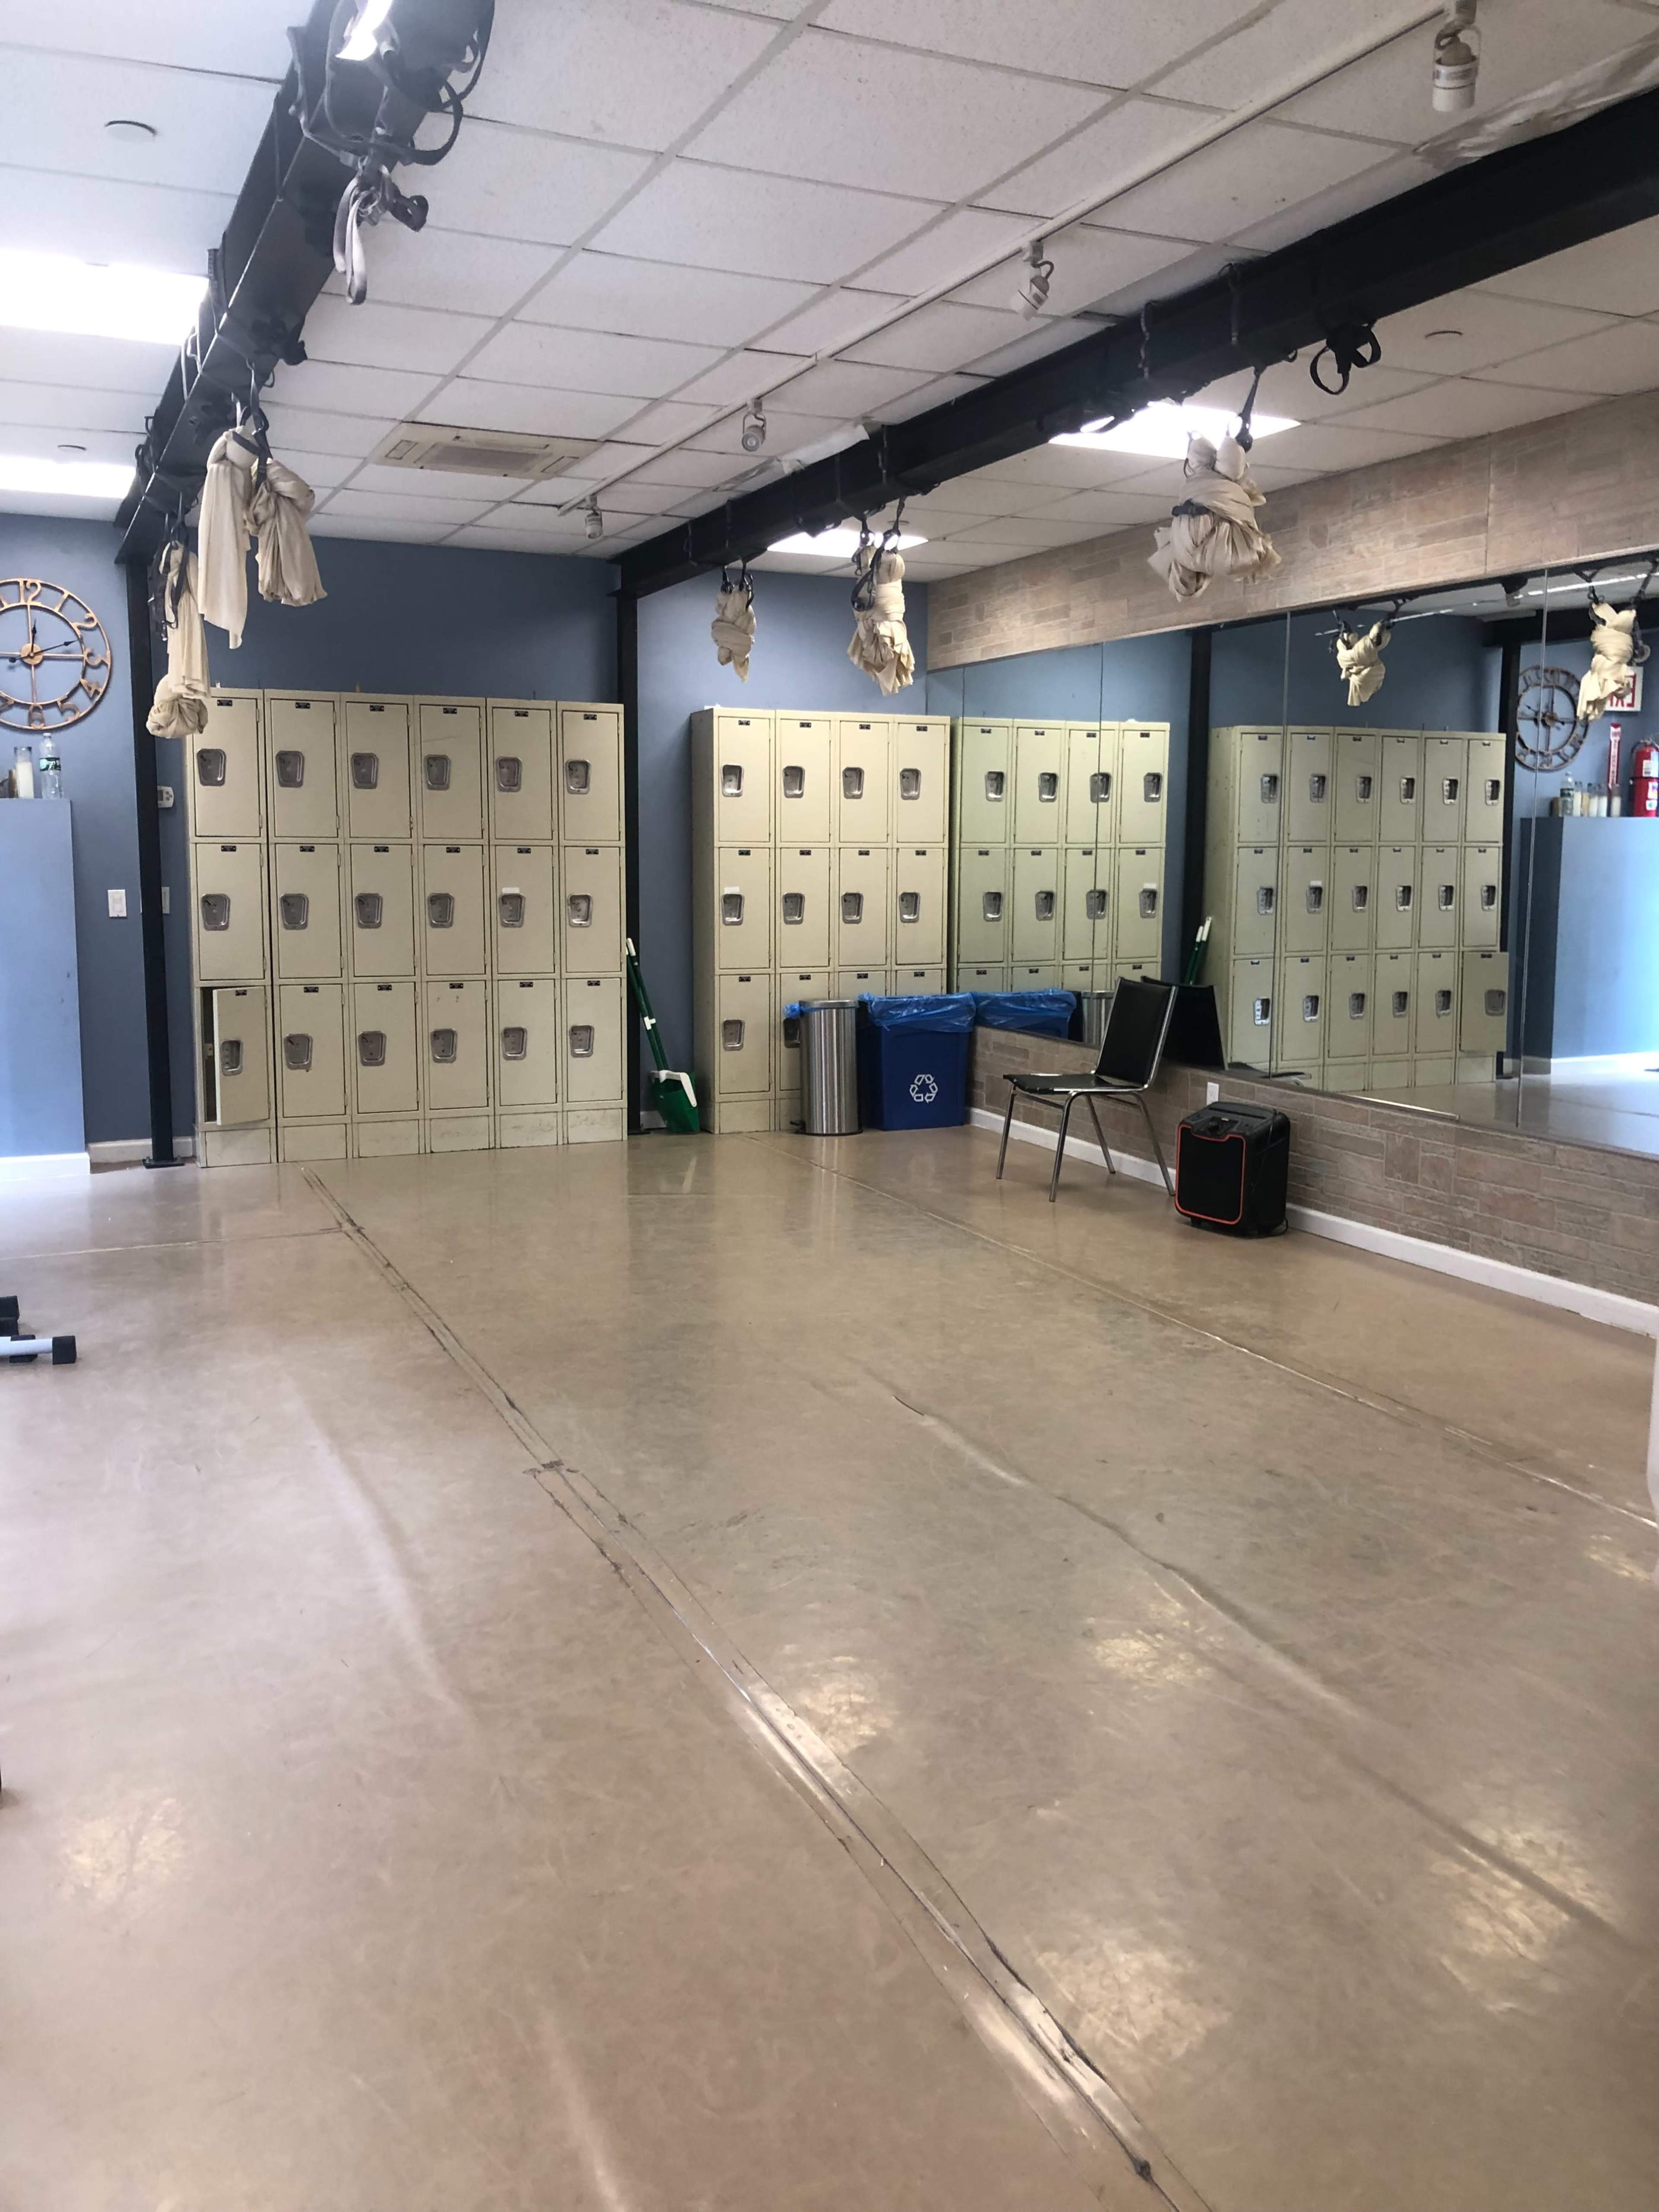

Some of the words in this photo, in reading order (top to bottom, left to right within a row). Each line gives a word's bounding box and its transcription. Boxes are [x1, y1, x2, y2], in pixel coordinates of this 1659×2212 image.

[19, 579, 41, 605] 12
[54, 592, 69, 612] 1
[71, 613, 98, 639] 2
[83, 648, 110, 666] 3
[79, 678, 103, 698] 4
[28, 703, 45, 730] 6
[57, 693, 80, 722] 5
